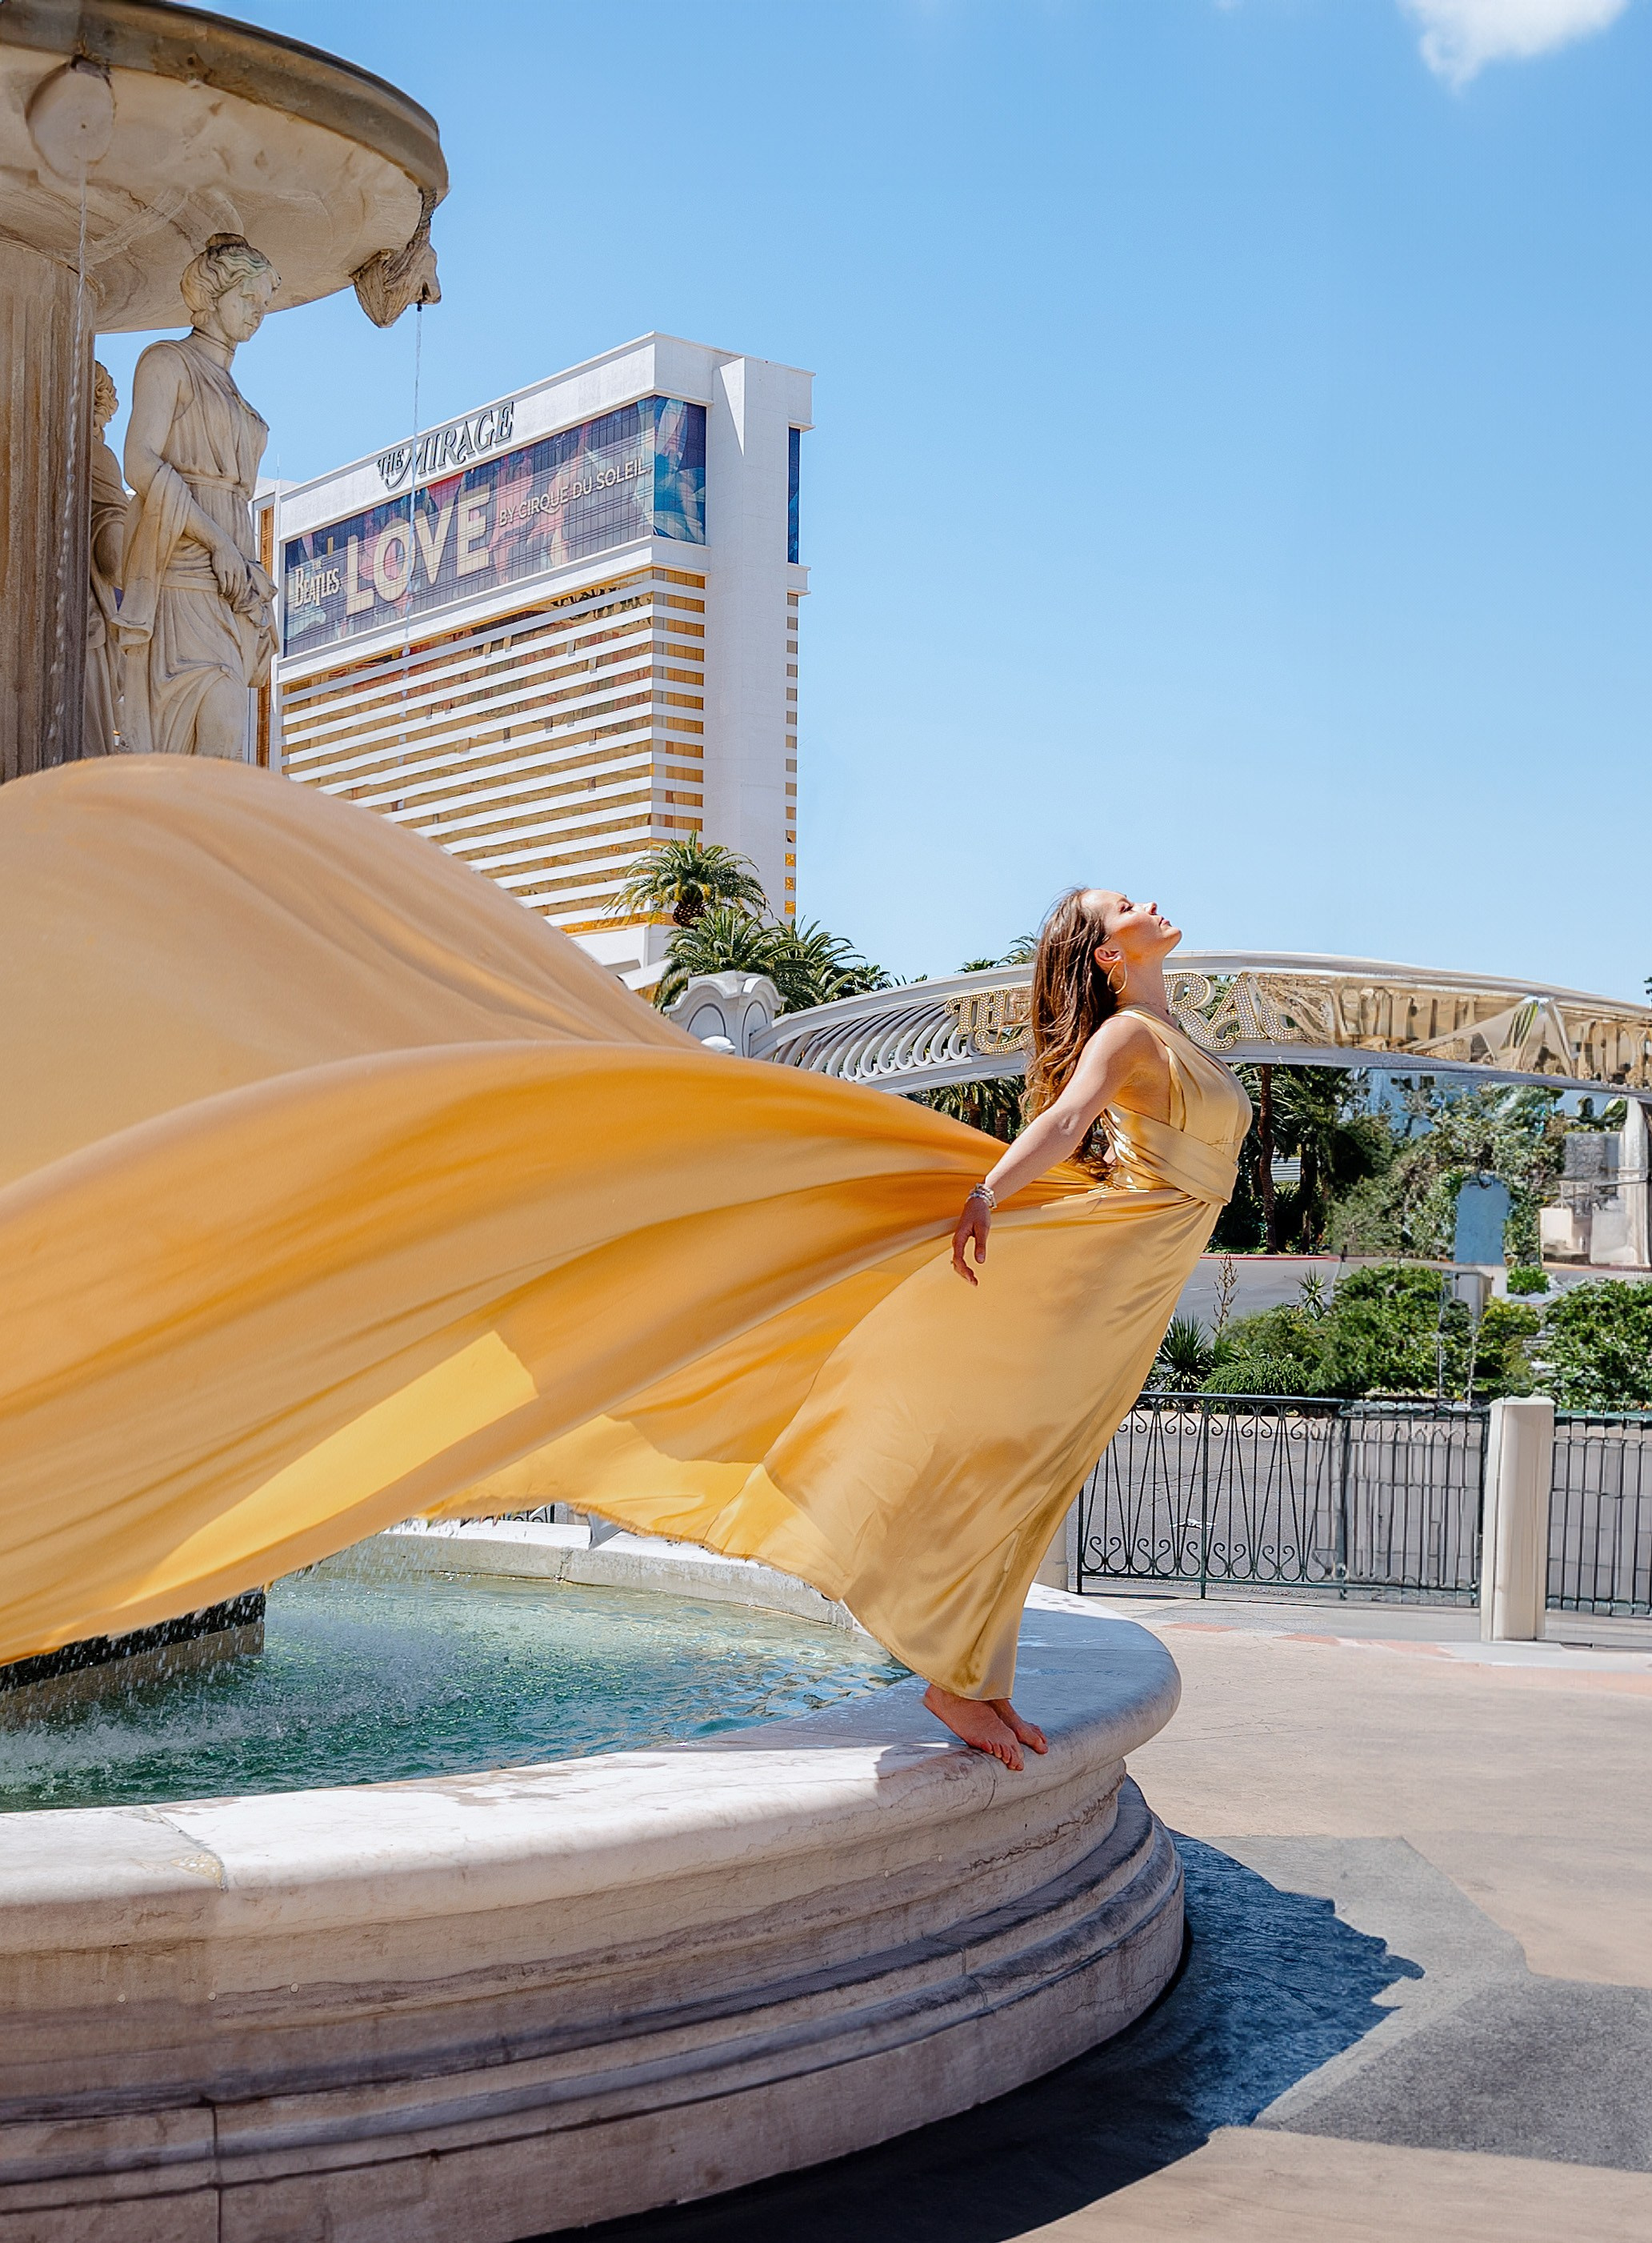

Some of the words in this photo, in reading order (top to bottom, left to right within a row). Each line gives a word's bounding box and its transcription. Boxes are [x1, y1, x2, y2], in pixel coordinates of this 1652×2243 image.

[377, 448, 405, 476] THE
[385, 402, 514, 489] MIRAGE
[499, 507, 517, 527] BY
[518, 486, 569, 519] CIRQUE
[573, 476, 593, 500] DU
[596, 457, 647, 491] SOLEIL
[346, 483, 490, 615] LOVE
[294, 567, 342, 608] BEATLES
